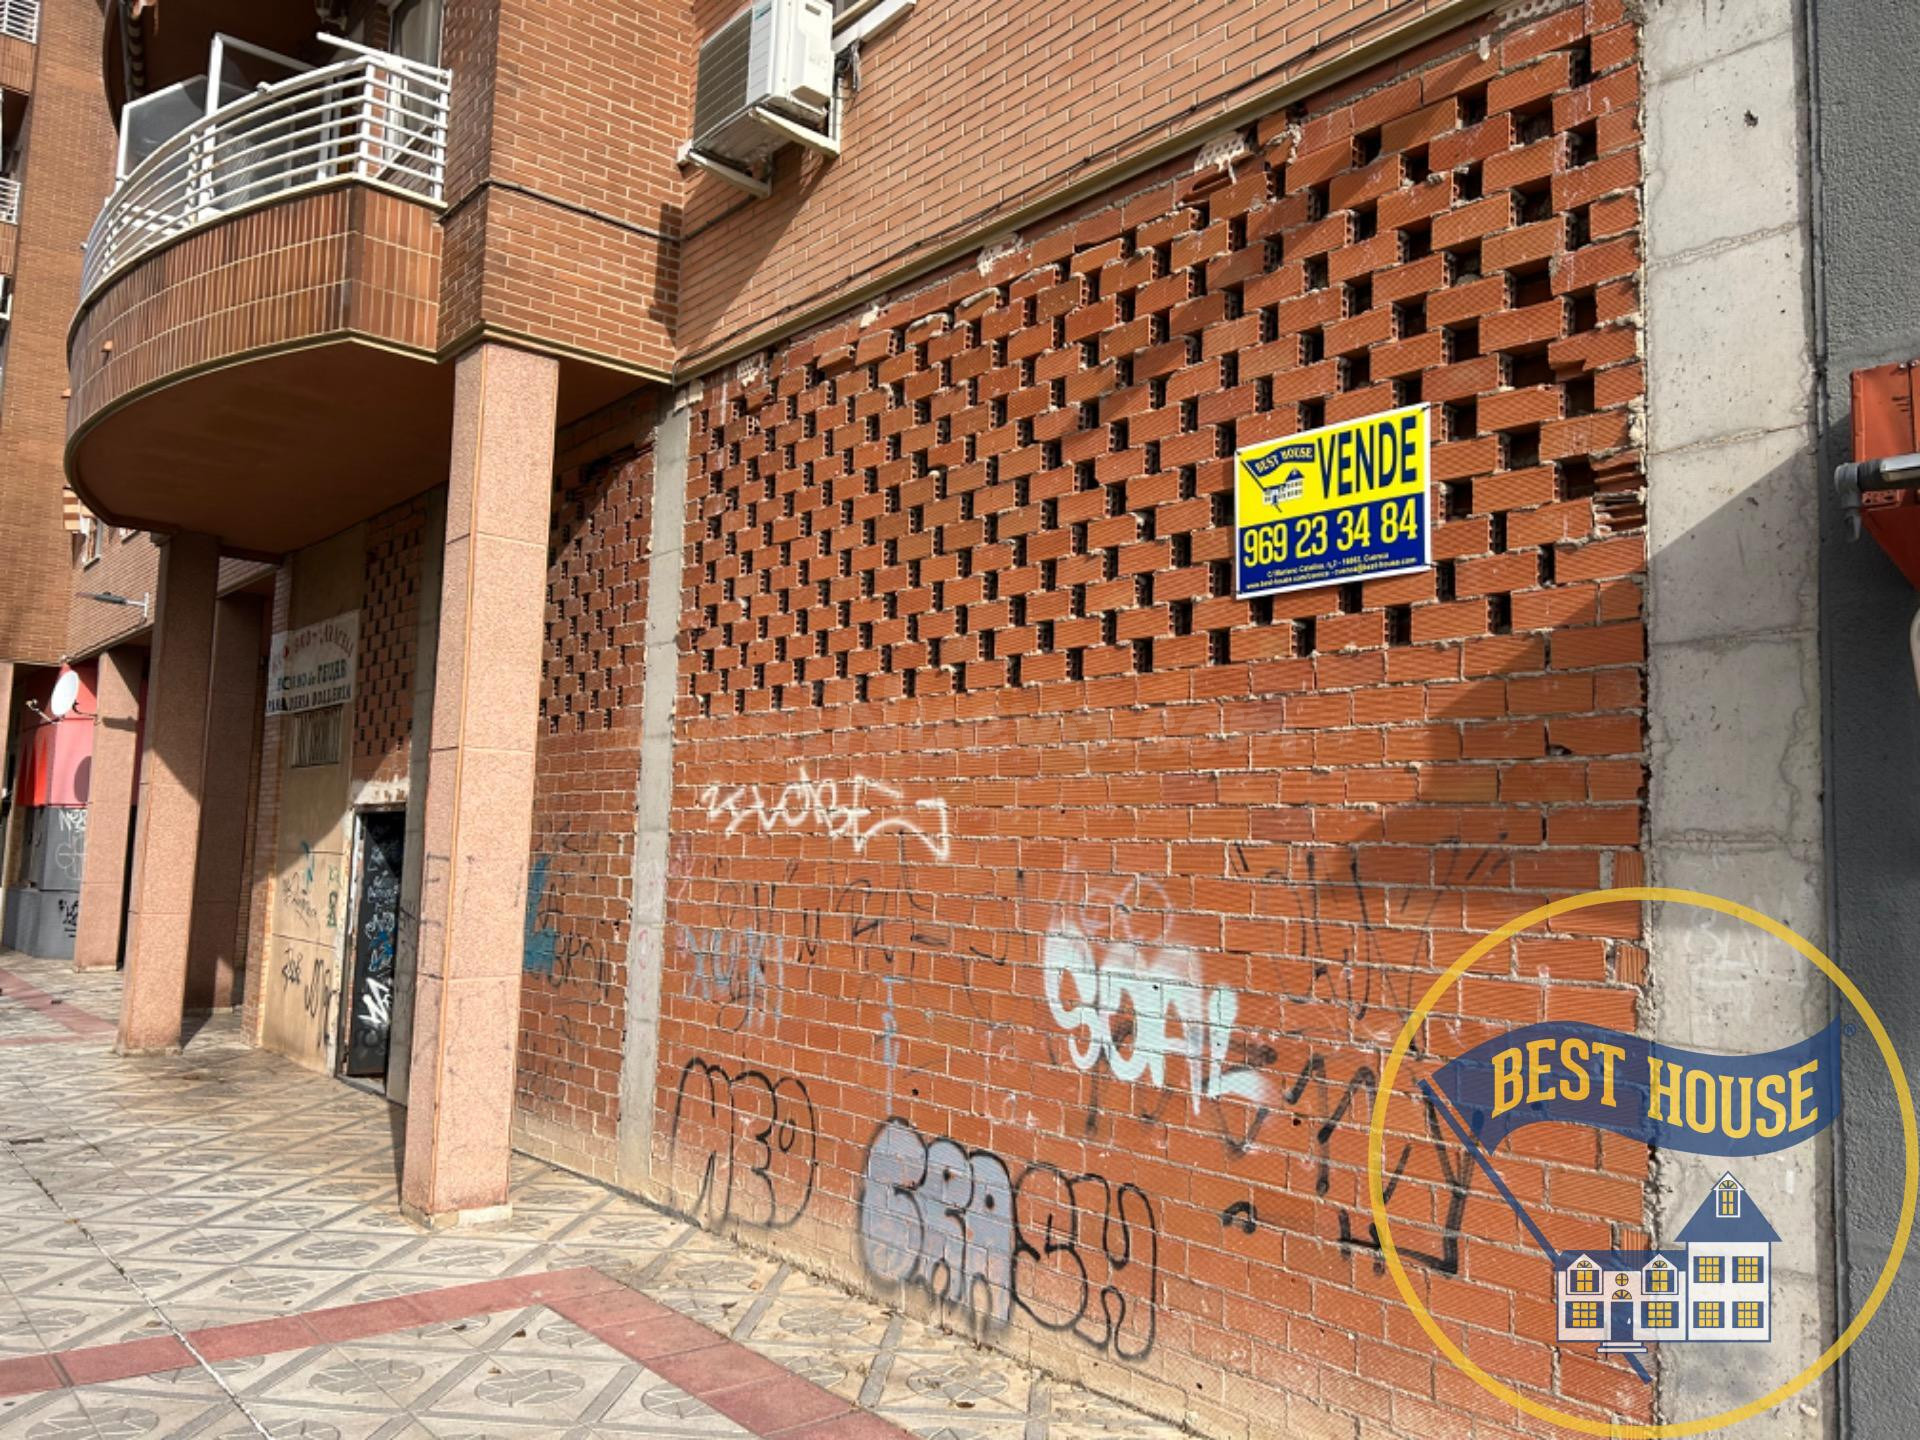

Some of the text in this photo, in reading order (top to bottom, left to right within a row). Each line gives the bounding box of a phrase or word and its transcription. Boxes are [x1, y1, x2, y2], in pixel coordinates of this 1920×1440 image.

[1255, 447, 1313, 473] BEST HOUSE
[1317, 415, 1417, 499] VENDE
[1243, 498, 1418, 567] 969 23 34 84
